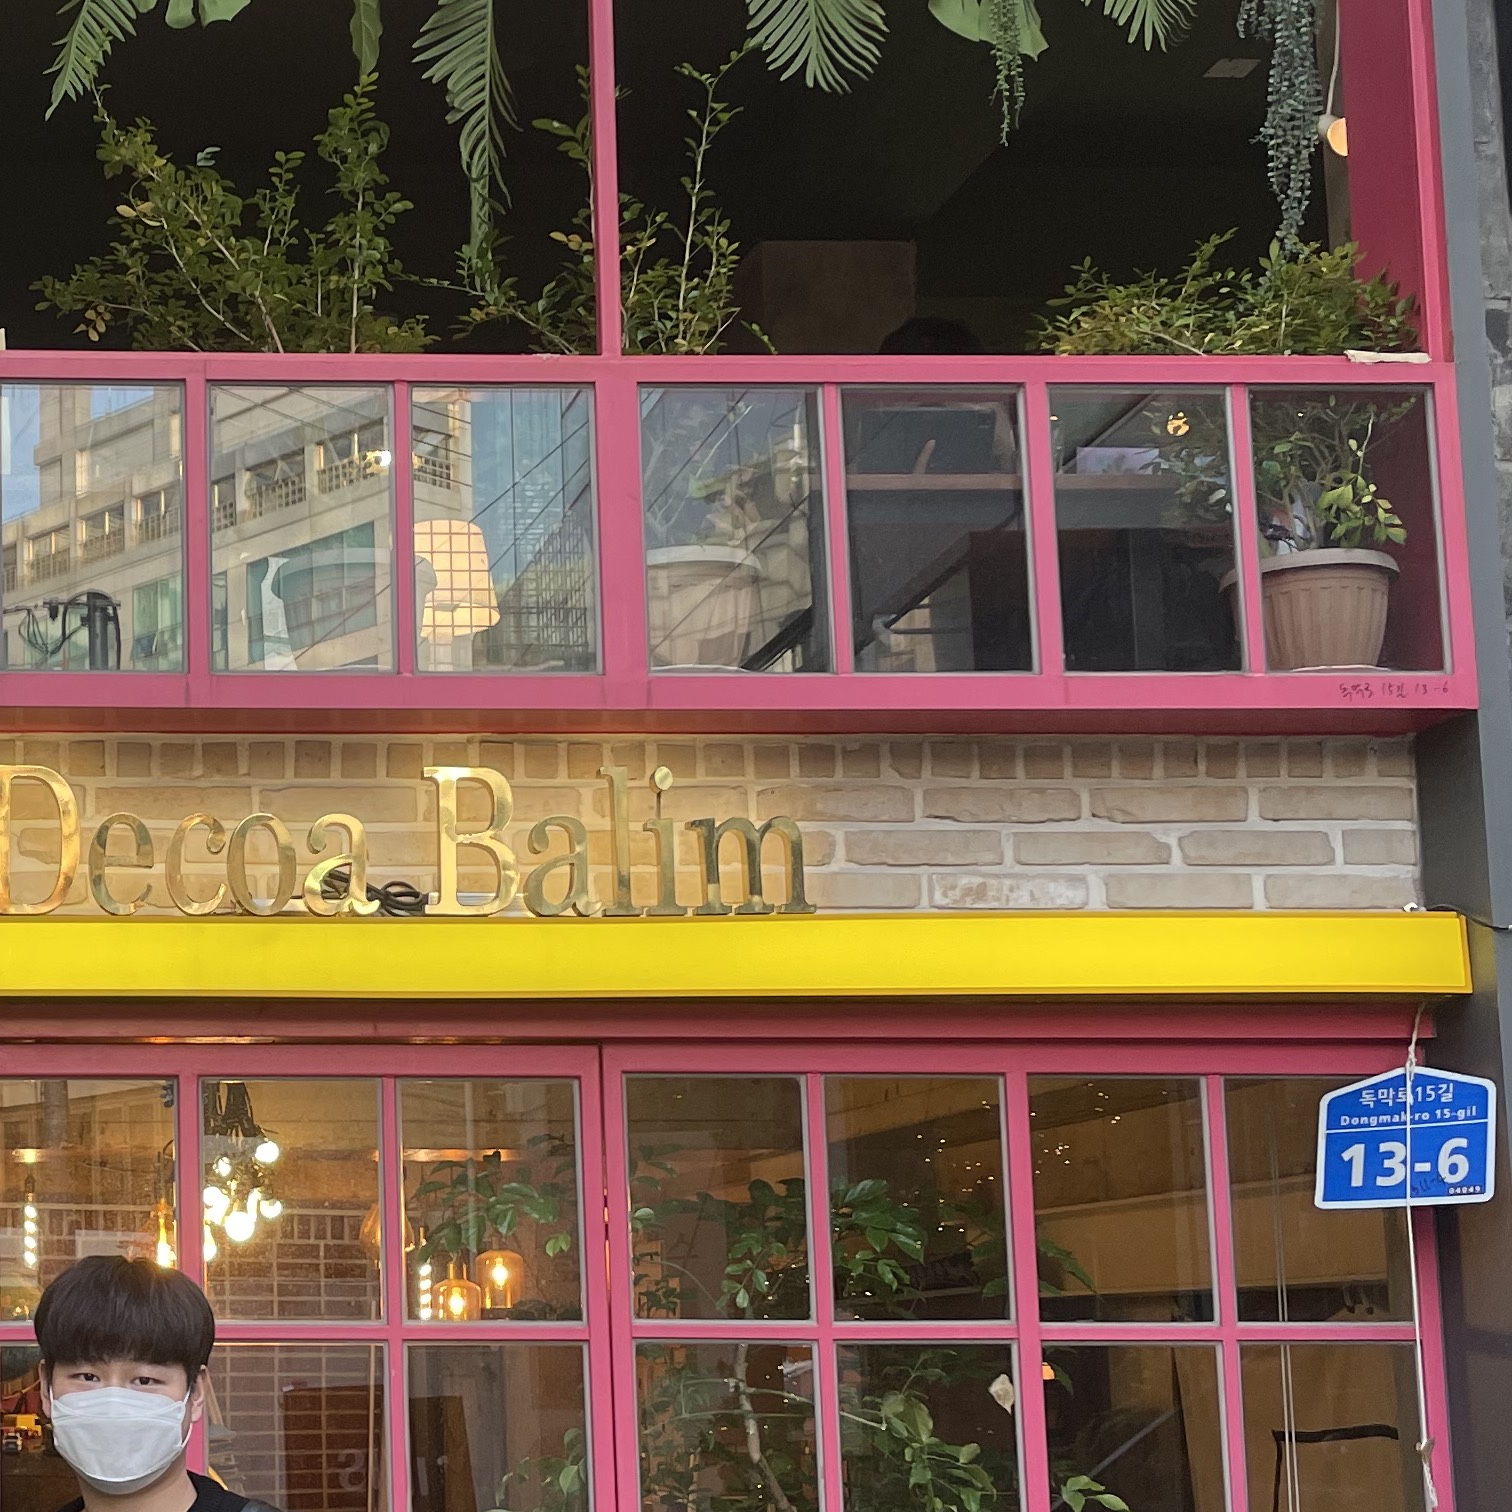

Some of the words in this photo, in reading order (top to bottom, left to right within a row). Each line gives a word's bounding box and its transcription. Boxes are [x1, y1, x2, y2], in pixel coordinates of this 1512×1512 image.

[423, 765, 818, 917] Balim
[1359, 1083, 1454, 1108] 독막로15길
[1340, 1112, 1430, 1127] Dongmak-ro
[1435, 1105, 1477, 1122] 15-gil
[1341, 1137, 1469, 1188] 13-6
